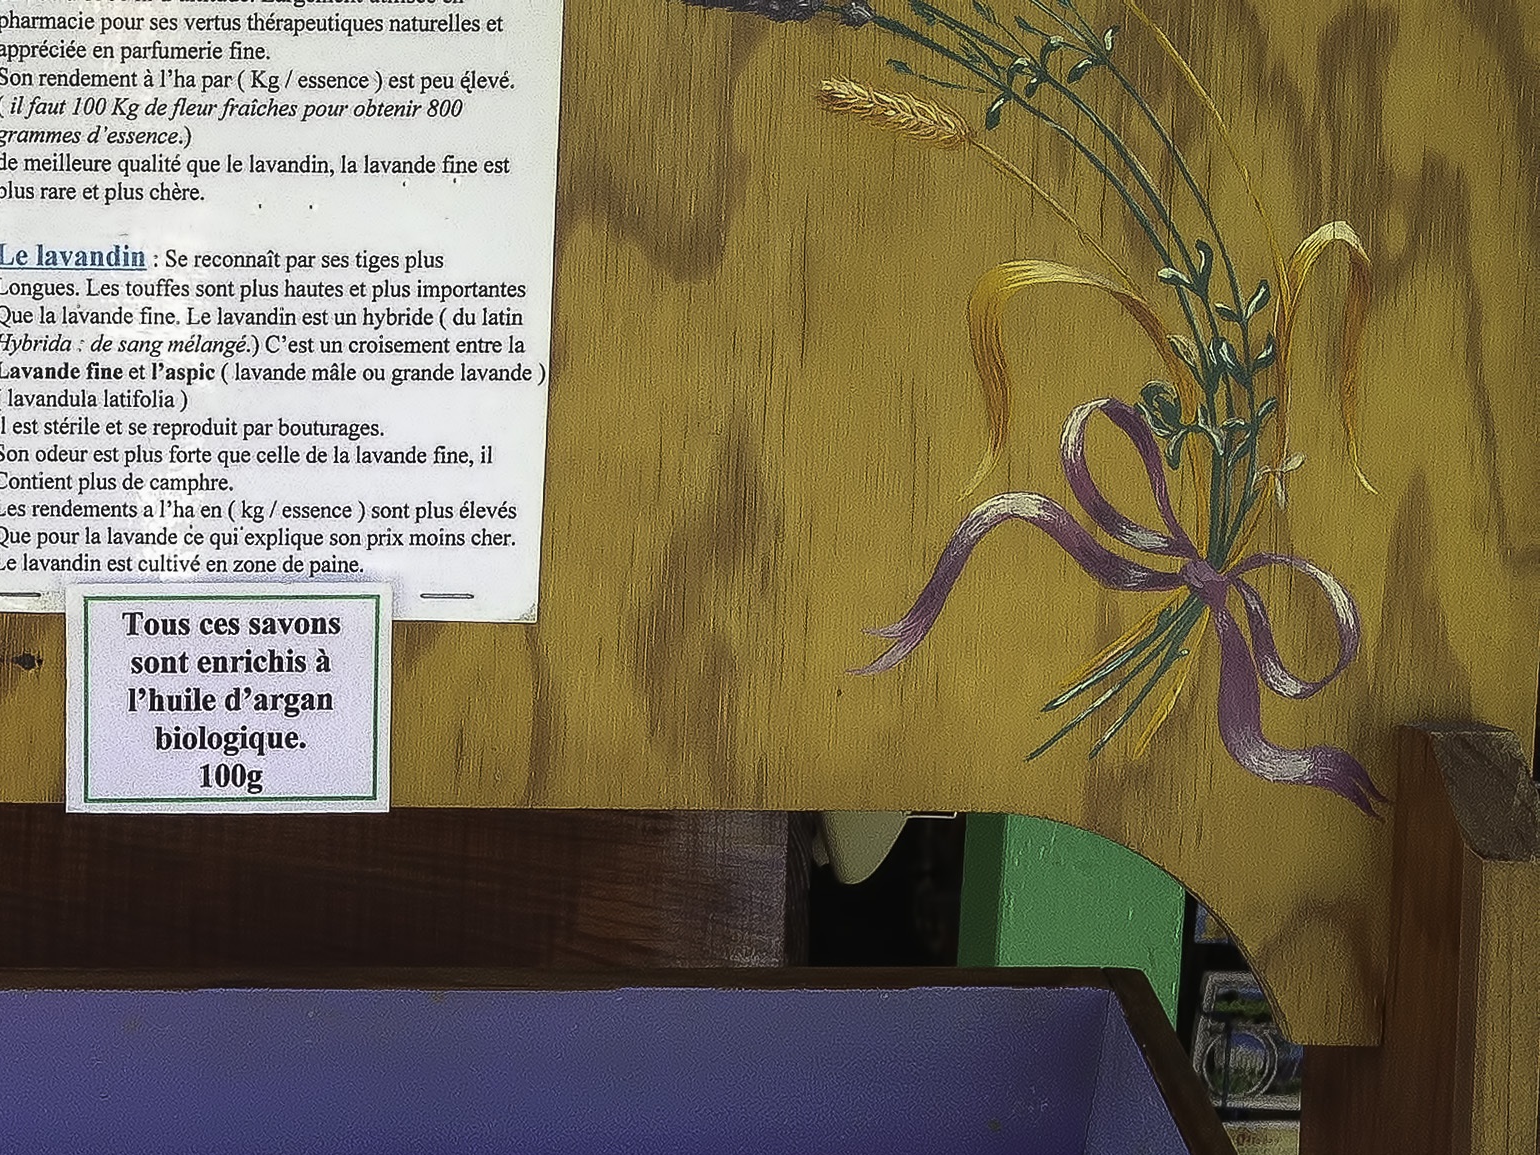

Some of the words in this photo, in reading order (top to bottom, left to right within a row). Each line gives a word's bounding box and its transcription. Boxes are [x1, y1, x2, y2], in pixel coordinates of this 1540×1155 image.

[99, 16, 145, 36] pour
[149, 16, 178, 32] ses
[183, 11, 242, 32] vertus
[246, 11, 384, 38] thérapeutiques
[388, 12, 481, 33] naturelles
[485, 15, 504, 33] et
[92, 45, 115, 59] en
[119, 39, 223, 65] parfumerie
[228, 40, 271, 61] fine.
[9, 95, 23, 116] il
[26, 95, 68, 121] faut
[71, 96, 109, 117] 100
[110, 97, 142, 121] Kg
[144, 96, 168, 117] de
[169, 95, 218, 122] fleur
[218, 97, 298, 122] fraîches
[301, 103, 350, 122] pour
[353, 98, 424, 119] obtenir
[426, 98, 464, 119] 800
[86, 124, 192, 150] d'essence.)
[23, 152, 112, 174] meilleure
[117, 152, 182, 178] qualité
[186, 159, 221, 179] que
[225, 153, 246, 174] le
[249, 153, 335, 178] lavandin,
[339, 154, 358, 174] la
[363, 154, 436, 174] lavande
[441, 154, 478, 174] fine
[483, 156, 511, 177] est
[39, 186, 77, 201] rare
[82, 184, 100, 201] et
[104, 181, 144, 205] plus
[149, 181, 205, 202] chère.
[36, 243, 149, 271] lavandin
[165, 248, 189, 268] Se
[193, 249, 281, 269] reconnaît
[285, 254, 317, 274] par
[320, 254, 350, 269] ses
[354, 249, 400, 274] tiges
[404, 249, 444, 274] plus
[39, 305, 57, 325] la
[61, 303, 134, 328] lavande
[138, 305, 181, 326] fine.
[185, 306, 212, 326] Le
[216, 306, 298, 326] lavandin
[301, 309, 329, 326] est
[333, 312, 357, 326] un
[362, 306, 434, 331] hybride
[452, 306, 477, 327] du
[481, 306, 524, 327] latin
[90, 333, 113, 353] de
[117, 339, 164, 358] sang
[167, 333, 260, 358] mélangé.)
[265, 334, 315, 354] C'est
[319, 340, 346, 354] un
[348, 334, 451, 354] croisement
[455, 337, 503, 354] entre
[507, 334, 527, 354] la
[85, 361, 124, 381] fine
[128, 364, 146, 381] et
[151, 362, 216, 386] l'aspic
[234, 361, 307, 382] lavande
[311, 361, 357, 382] mâle
[362, 367, 386, 382] ou
[390, 362, 455, 386] grande
[460, 362, 533, 382] lavande
[7, 387, 98, 410] lavandula
[103, 388, 176, 409] latifolia
[35, 443, 89, 463] odeur
[92, 447, 120, 463] est
[123, 444, 164, 468] plus
[168, 444, 213, 464] forte
[216, 450, 255, 469] que
[256, 444, 301, 464] celle
[305, 445, 328, 464] de
[332, 445, 351, 464] la
[354, 444, 427, 465] lavande
[432, 445, 475, 468] fine,
[480, 444, 493, 465] il
[31, 498, 138, 519] rendements
[142, 505, 155, 519] a
[159, 499, 196, 519] l'ha
[199, 504, 223, 519] en
[240, 499, 265, 524] kg
[281, 505, 354, 520] essence
[371, 502, 411, 520] sont
[413, 500, 454, 524] plus
[459, 500, 518, 520] élevés
[21, 552, 102, 572] lavandin
[106, 556, 134, 573] est
[137, 553, 202, 573] cultivé
[205, 559, 230, 574] en
[232, 558, 278, 574] zone
[282, 554, 304, 574] de
[309, 555, 365, 578] paine.
[123, 611, 191, 636] Tous
[198, 618, 241, 635] ces
[249, 616, 342, 635] savons
[131, 652, 190, 674] sont
[197, 649, 308, 674] enrichis
[315, 649, 333, 673] à
[128, 687, 216, 713] l'huile
[226, 687, 334, 718] d'argan
[155, 726, 307, 756] biologique.
[200, 763, 264, 795] 100g
